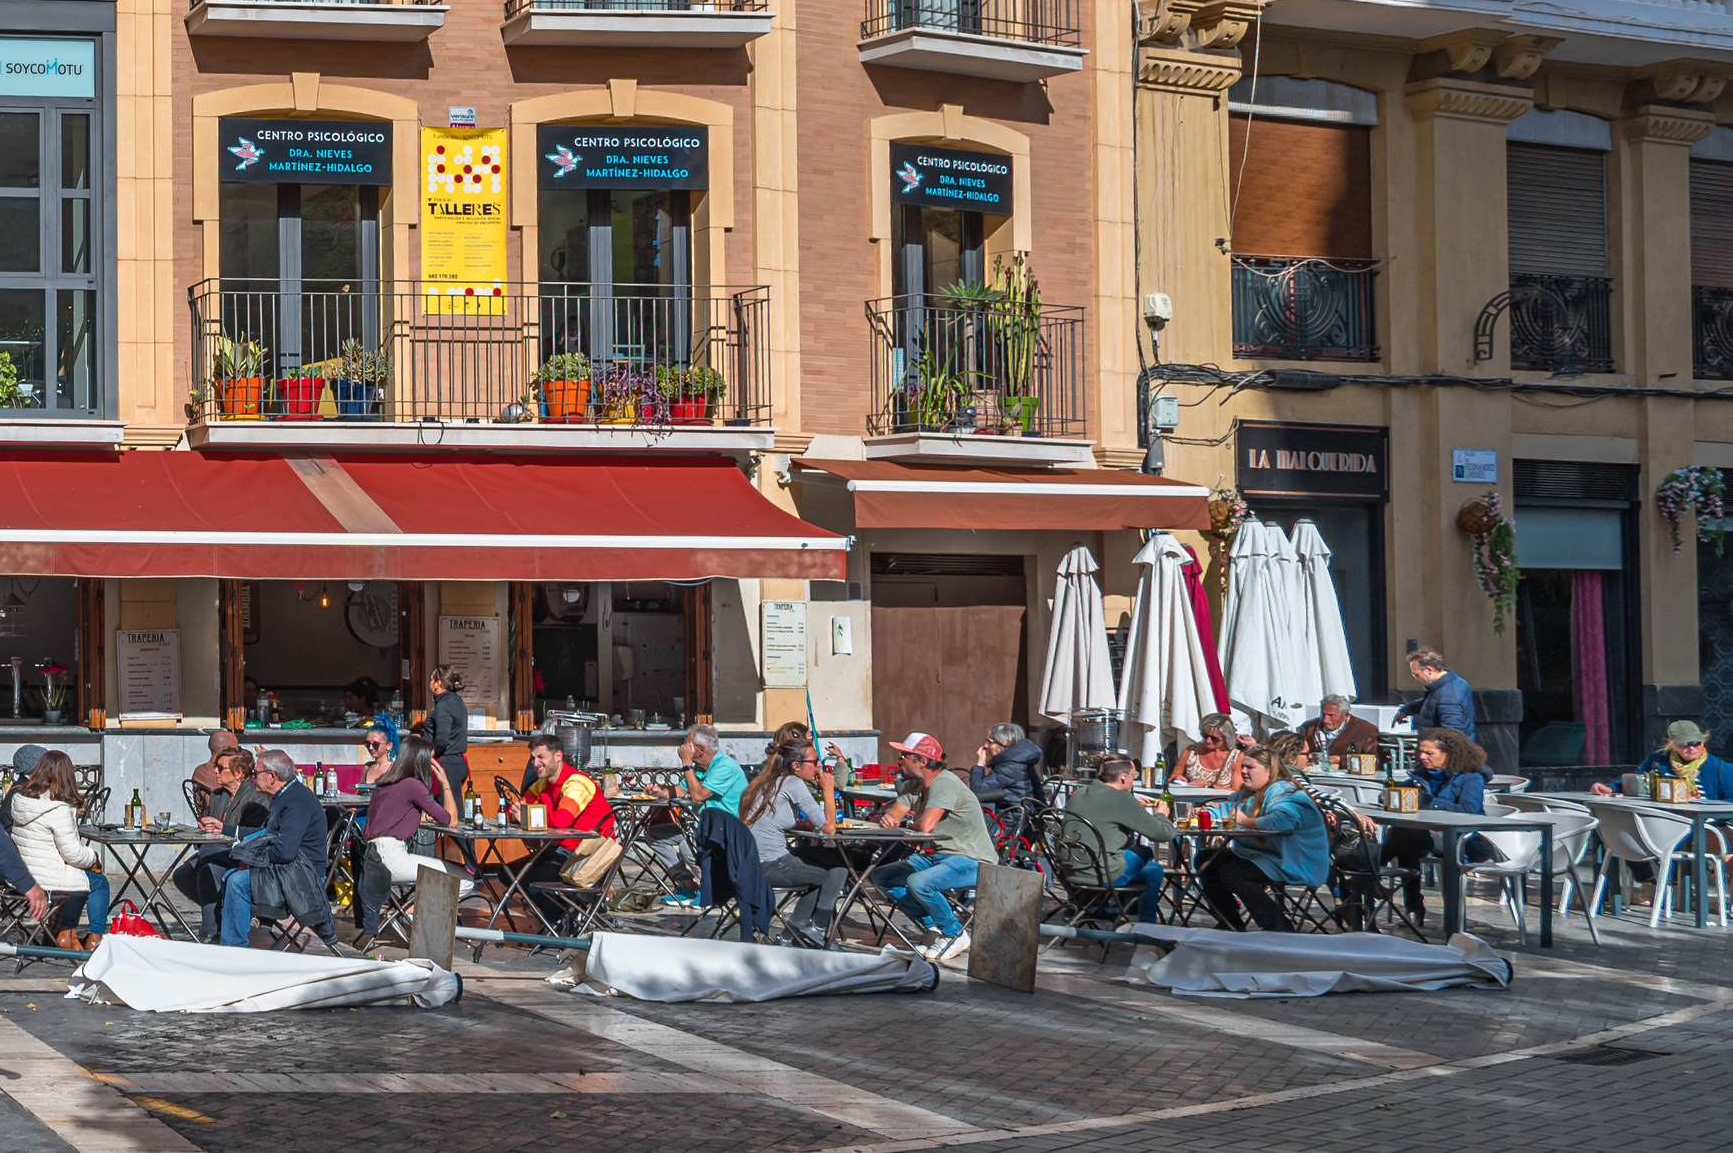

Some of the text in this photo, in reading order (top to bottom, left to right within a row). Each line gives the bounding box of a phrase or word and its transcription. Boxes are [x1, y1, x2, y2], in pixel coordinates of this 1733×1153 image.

[257, 130, 385, 143] CENTRO PSICOLÓGICO
[574, 136, 701, 149] CENTRO PSICOLÓGICO
[289, 149, 353, 159] DRA. NIEVES
[605, 155, 669, 165] DRA. NIEVES
[269, 161, 373, 174] MARTÍNEZ-HIDALGO
[917, 155, 1009, 175] CENTRO PSICOLÓGICO
[586, 167, 689, 179] MARTÍNEZ-HIDALGO
[939, 175, 986, 189] DRA. NIEVES
[925, 187, 1000, 203] MARTÍNEZ-HIDALGO
[428, 202, 502, 216] TALLERES
[1248, 449, 1377, 473] LA MALQUERIDA
[242, 585, 251, 629] ALHAMBRA
[449, 620, 486, 630] TRAPERIA
[127, 633, 164, 644] TRAPERIA
